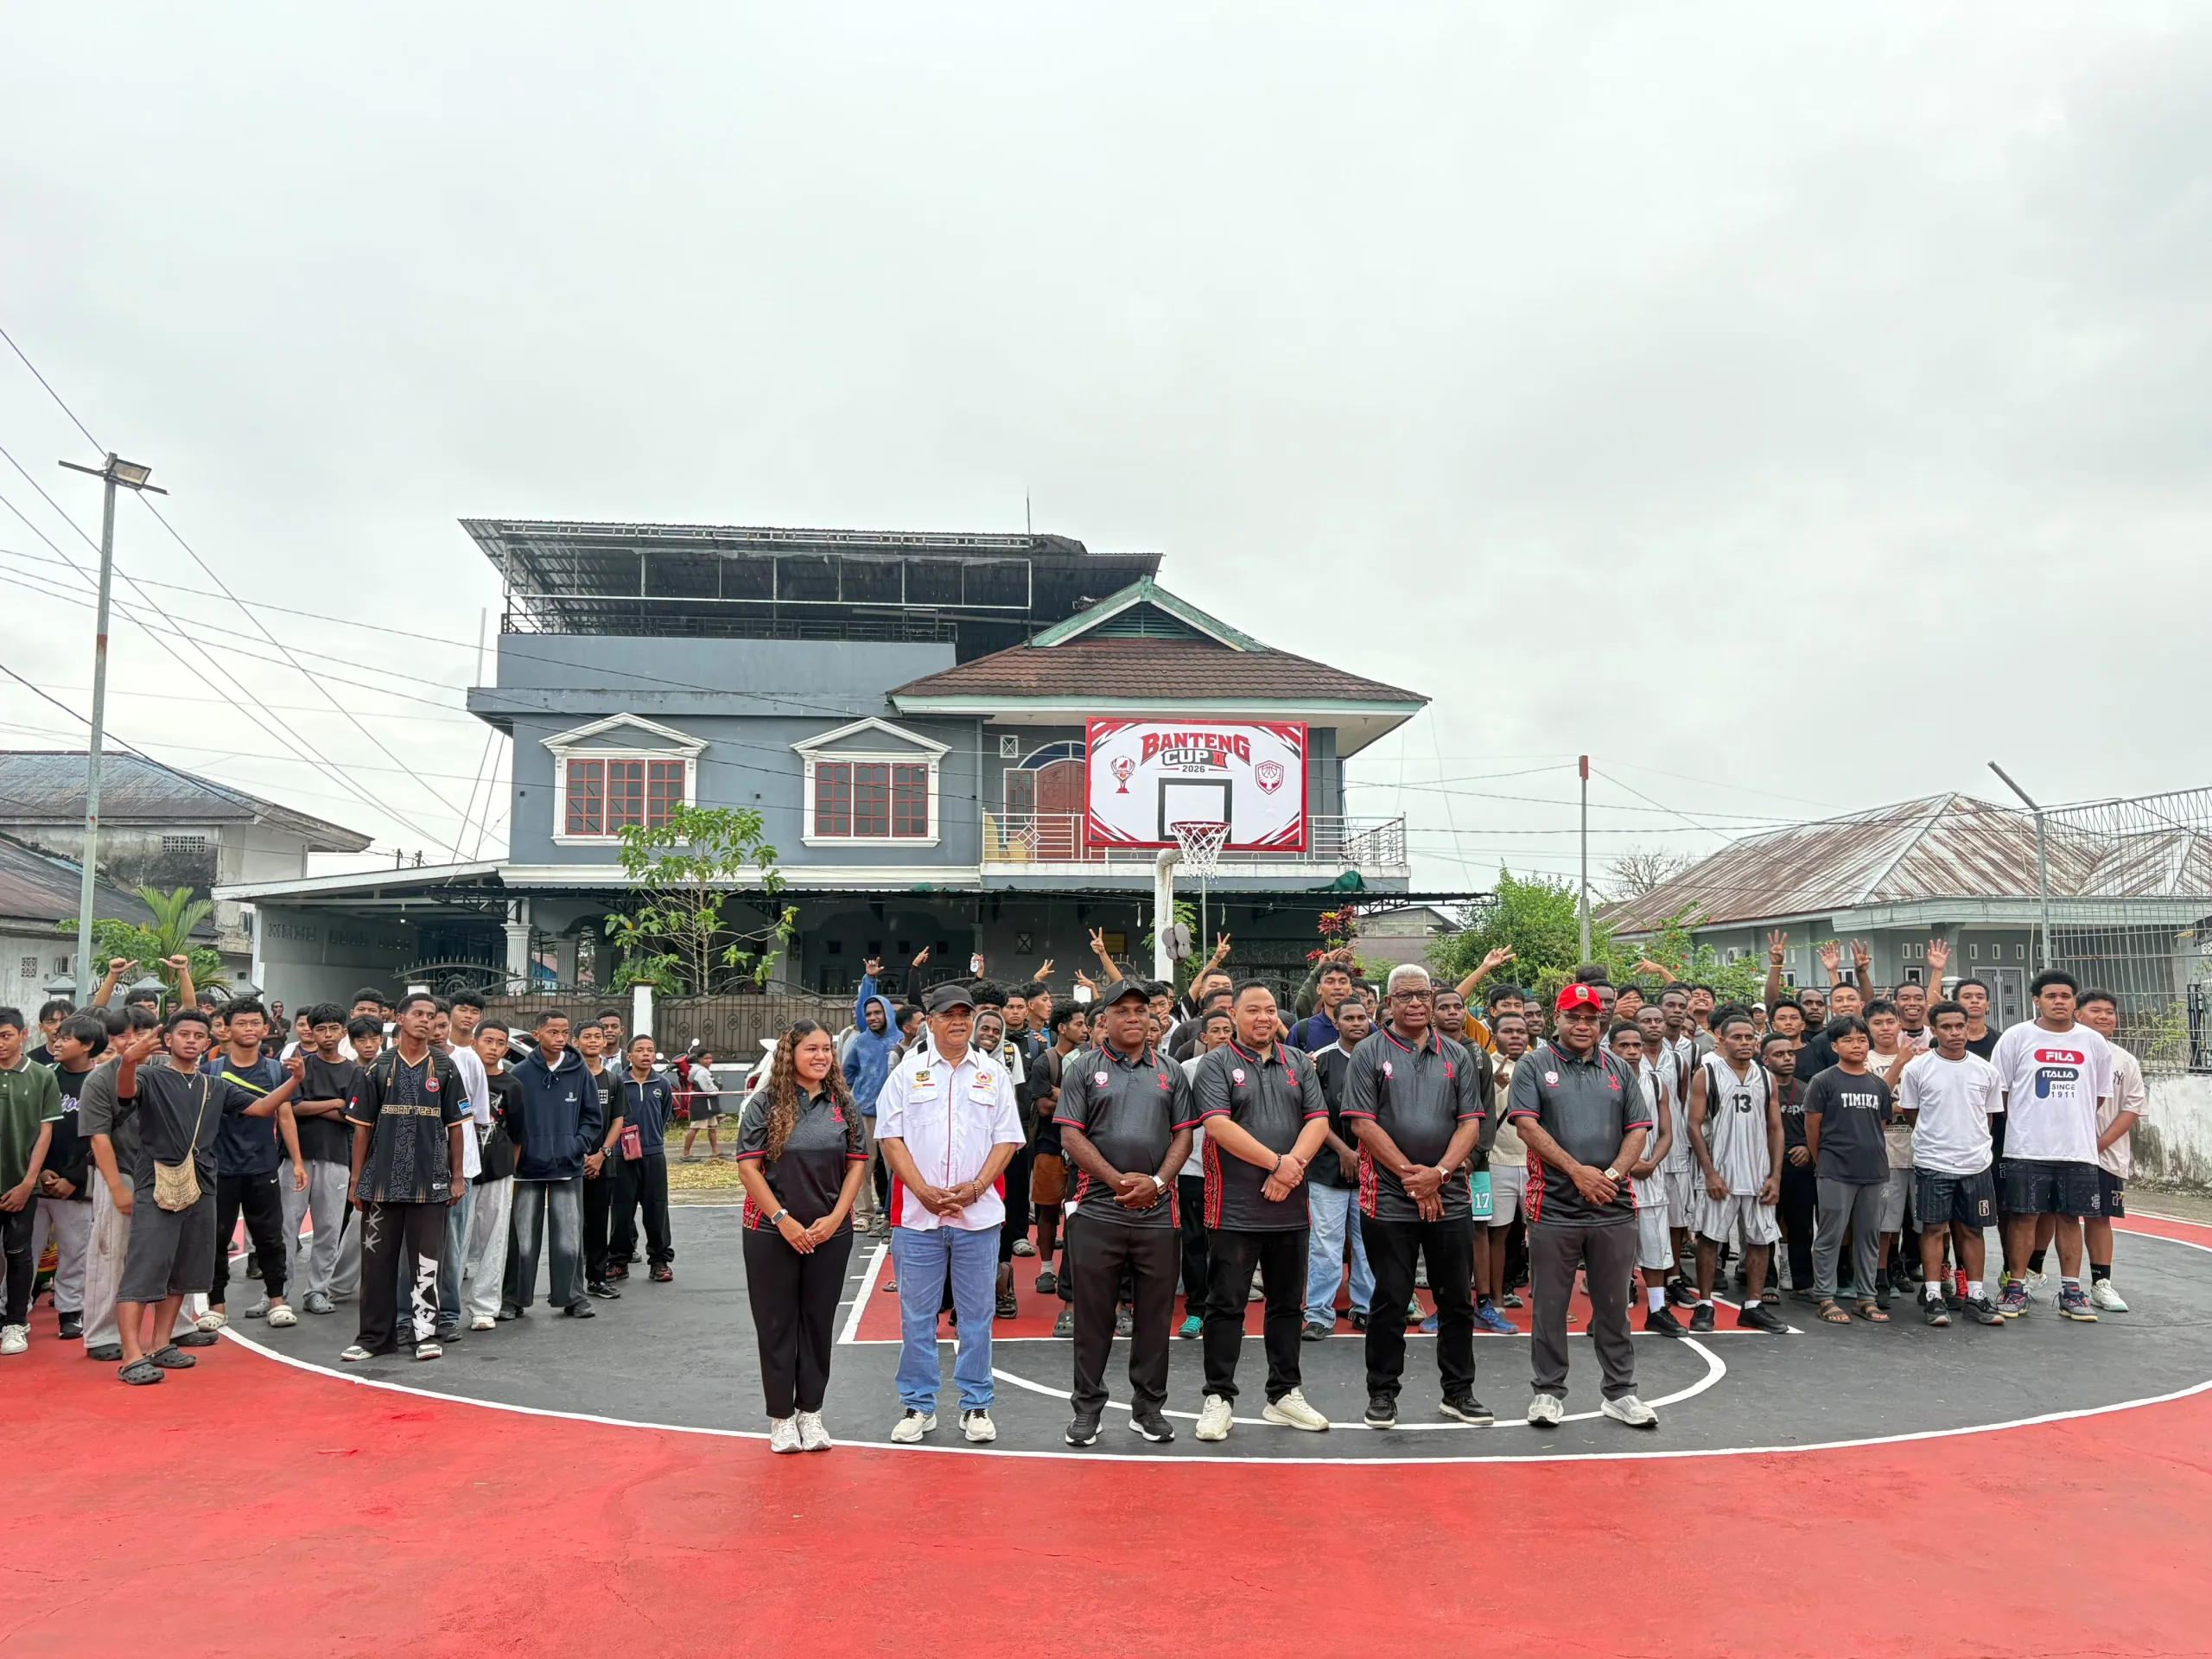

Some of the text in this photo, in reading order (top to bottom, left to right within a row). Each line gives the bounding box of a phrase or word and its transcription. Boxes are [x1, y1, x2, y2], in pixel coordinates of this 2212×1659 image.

[1140, 733, 1251, 766] BANTENG
[1164, 749, 1225, 766] CUP II
[1182, 765, 1205, 773] 2026
[2045, 1051, 2075, 1062] FILA
[2042, 1070, 2075, 1078] ITALIA
[1732, 1093, 1751, 1113] 13
[1840, 1093, 1879, 1110] TIMIKA
[1475, 1192, 1491, 1210] 17
